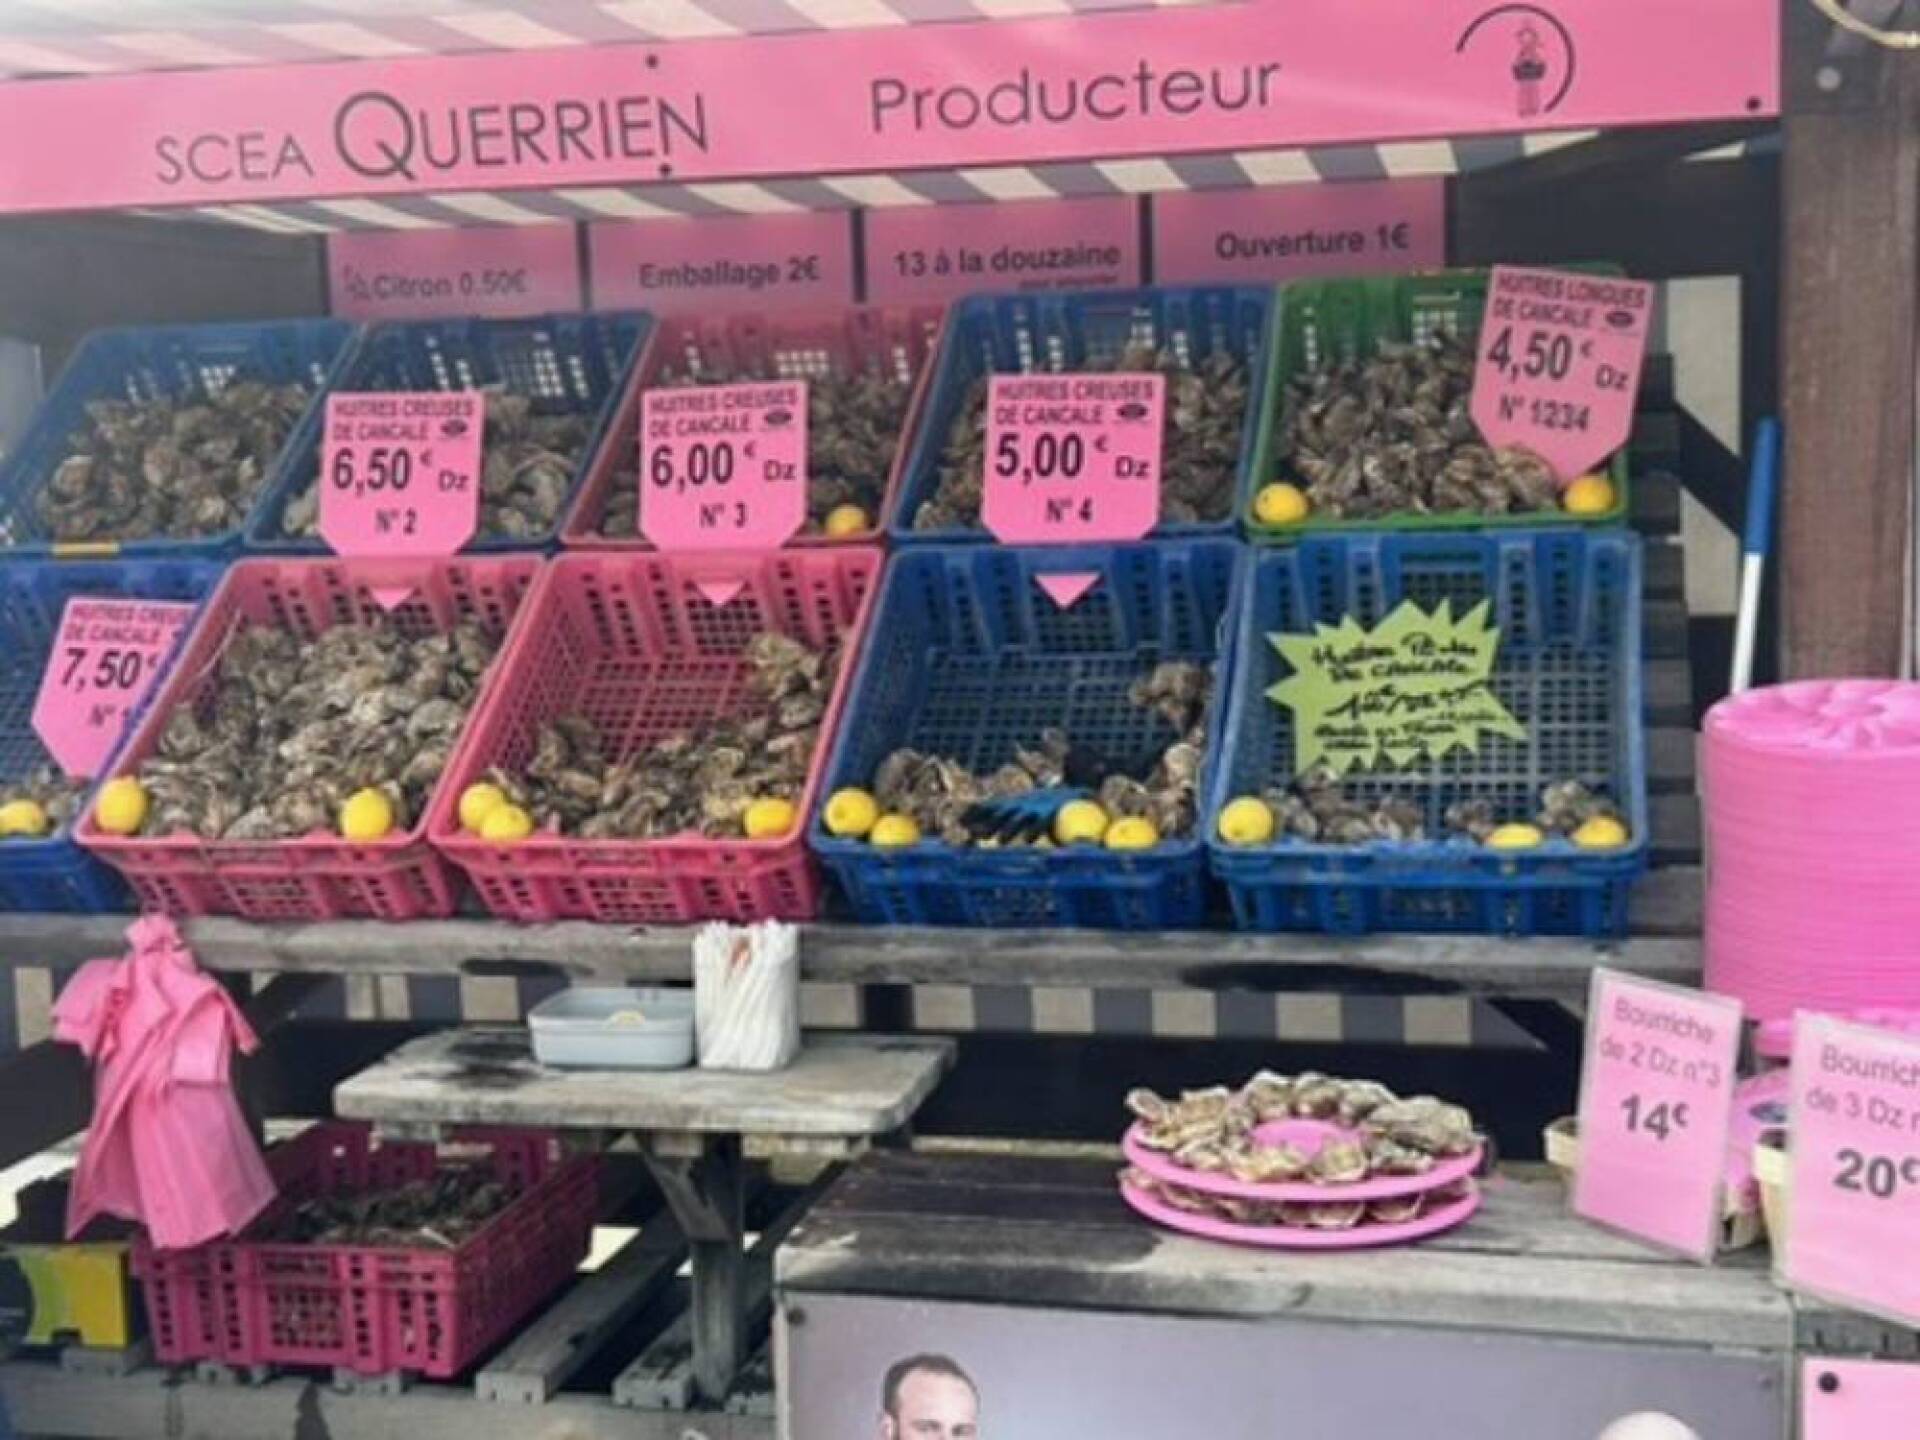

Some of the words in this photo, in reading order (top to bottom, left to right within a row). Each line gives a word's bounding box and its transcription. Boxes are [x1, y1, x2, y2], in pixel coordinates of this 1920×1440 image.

[871, 61, 1281, 133] Producteur
[155, 130, 313, 185] SCEA
[334, 92, 711, 181] QUERRIEN
[1215, 231, 1366, 260] Ouverture
[1376, 222, 1411, 250] 1€
[639, 261, 781, 290] Emballage
[787, 255, 821, 281] 2€
[893, 251, 926, 276] 13
[934, 247, 952, 275] à
[959, 247, 983, 272] la
[991, 242, 1121, 272] douzaine
[374, 274, 452, 299] Citron
[1494, 297, 1514, 319] DE
[1519, 301, 1592, 327] CANCALE
[1488, 326, 1572, 383] 4,50
[1074, 379, 1153, 401] CREUSES
[1597, 364, 1628, 390] Dz
[404, 400, 473, 416] CREUSES
[724, 387, 797, 409] CREUSES
[651, 420, 670, 438] DE
[676, 414, 750, 436] CANCALE
[996, 405, 1017, 424] DE
[1025, 404, 1102, 425] CANCALE
[1531, 400, 1589, 429] 1234
[334, 423, 353, 440] DE
[359, 422, 428, 441] CANCALE
[334, 448, 412, 498] 6,50
[652, 442, 734, 494] 6,00
[764, 460, 796, 481] Dz
[996, 432, 1084, 485] 5,00
[1115, 456, 1149, 480] Dz
[438, 471, 469, 491] Dz
[404, 507, 416, 534] 2
[735, 501, 746, 527] 3
[1079, 498, 1092, 521] 4
[64, 623, 84, 641] DE
[91, 624, 161, 645] CANCALE
[61, 647, 142, 694] 7,50
[1614, 996, 1715, 1046] Bourriche
[1600, 1035, 1625, 1060] de
[1629, 1041, 1645, 1067] 2
[1649, 1046, 1679, 1076] Dz
[1820, 1043, 1920, 1087] Bourrich
[1805, 1087, 1838, 1114] de
[1845, 1091, 1862, 1119] 3
[1868, 1095, 1905, 1128] Dz
